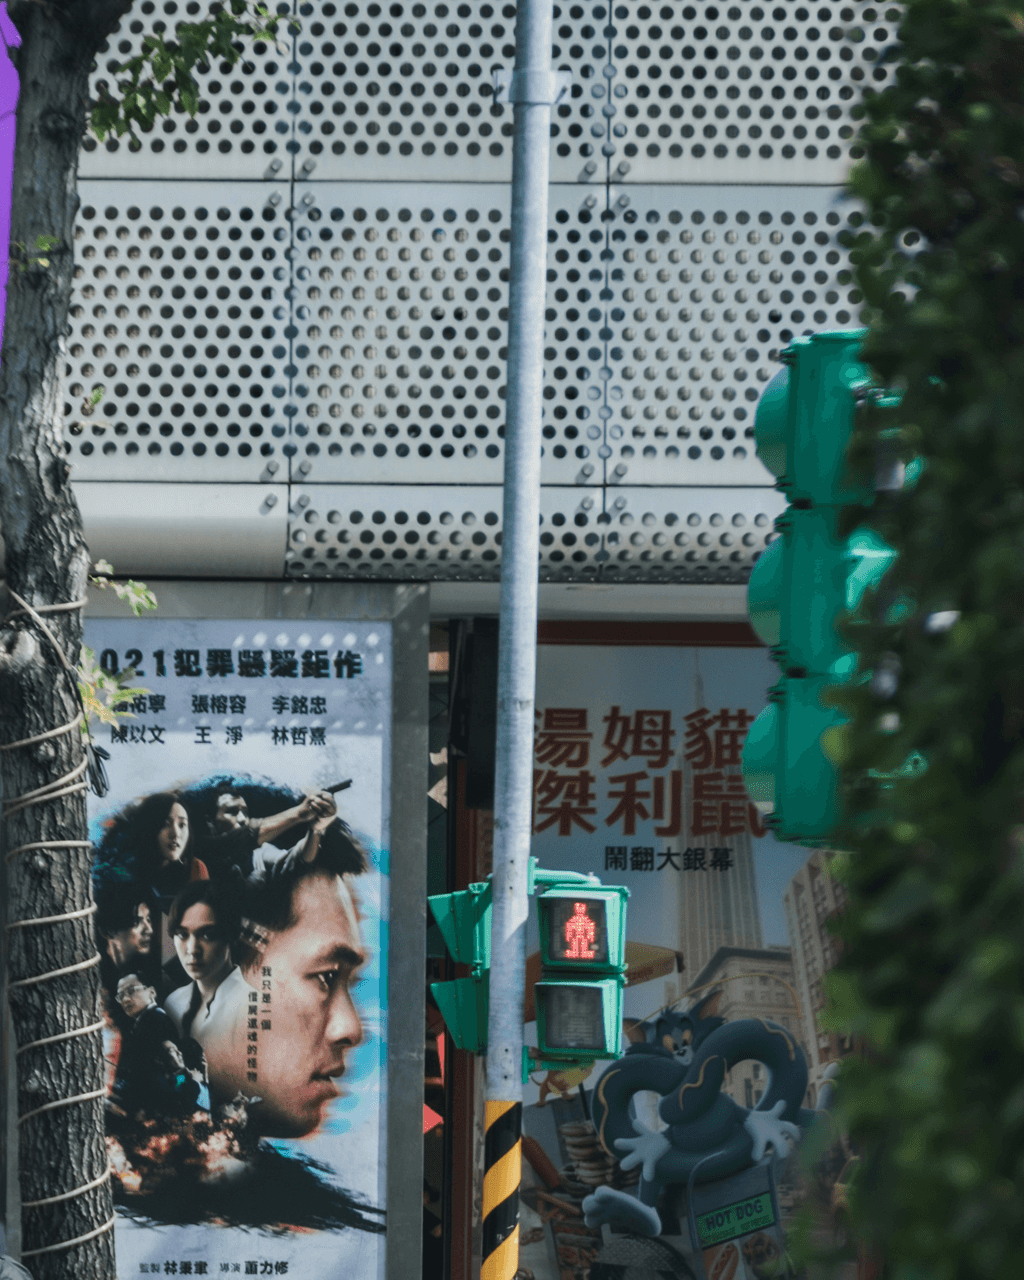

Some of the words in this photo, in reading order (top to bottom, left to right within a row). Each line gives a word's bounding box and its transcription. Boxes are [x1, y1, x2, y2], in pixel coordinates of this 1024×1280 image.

[191, 694, 247, 714] 張榕容
[604, 846, 735, 872] 鬧翻大銀幕
[704, 1209, 732, 1231] HOT
[736, 1198, 764, 1221] DOG
